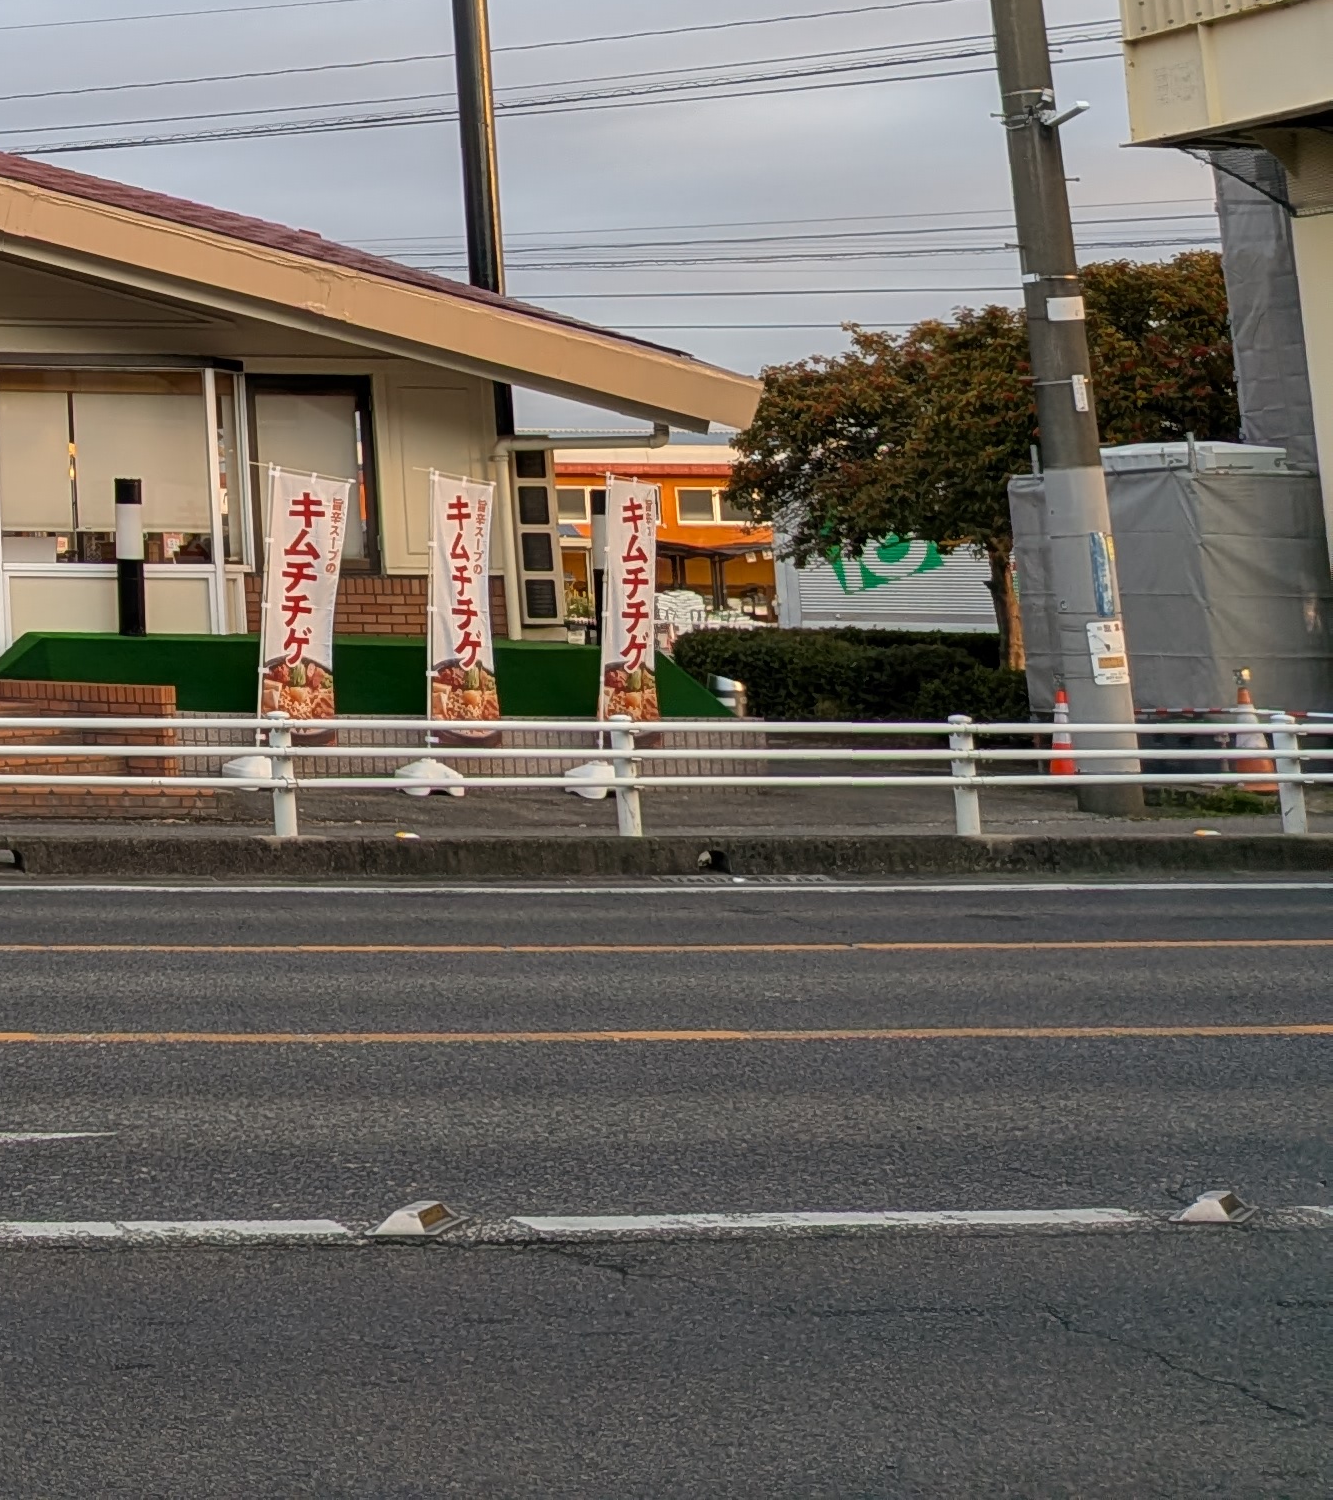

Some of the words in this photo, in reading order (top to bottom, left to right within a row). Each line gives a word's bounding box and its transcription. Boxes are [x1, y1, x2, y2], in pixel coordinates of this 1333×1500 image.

[281, 492, 326, 668] キムチチゲ
[325, 498, 345, 575] 旨辛スープの
[446, 495, 483, 670] キムチチゲ
[472, 499, 488, 576] 旨辛スープの
[620, 497, 649, 671] キムチチゲ
